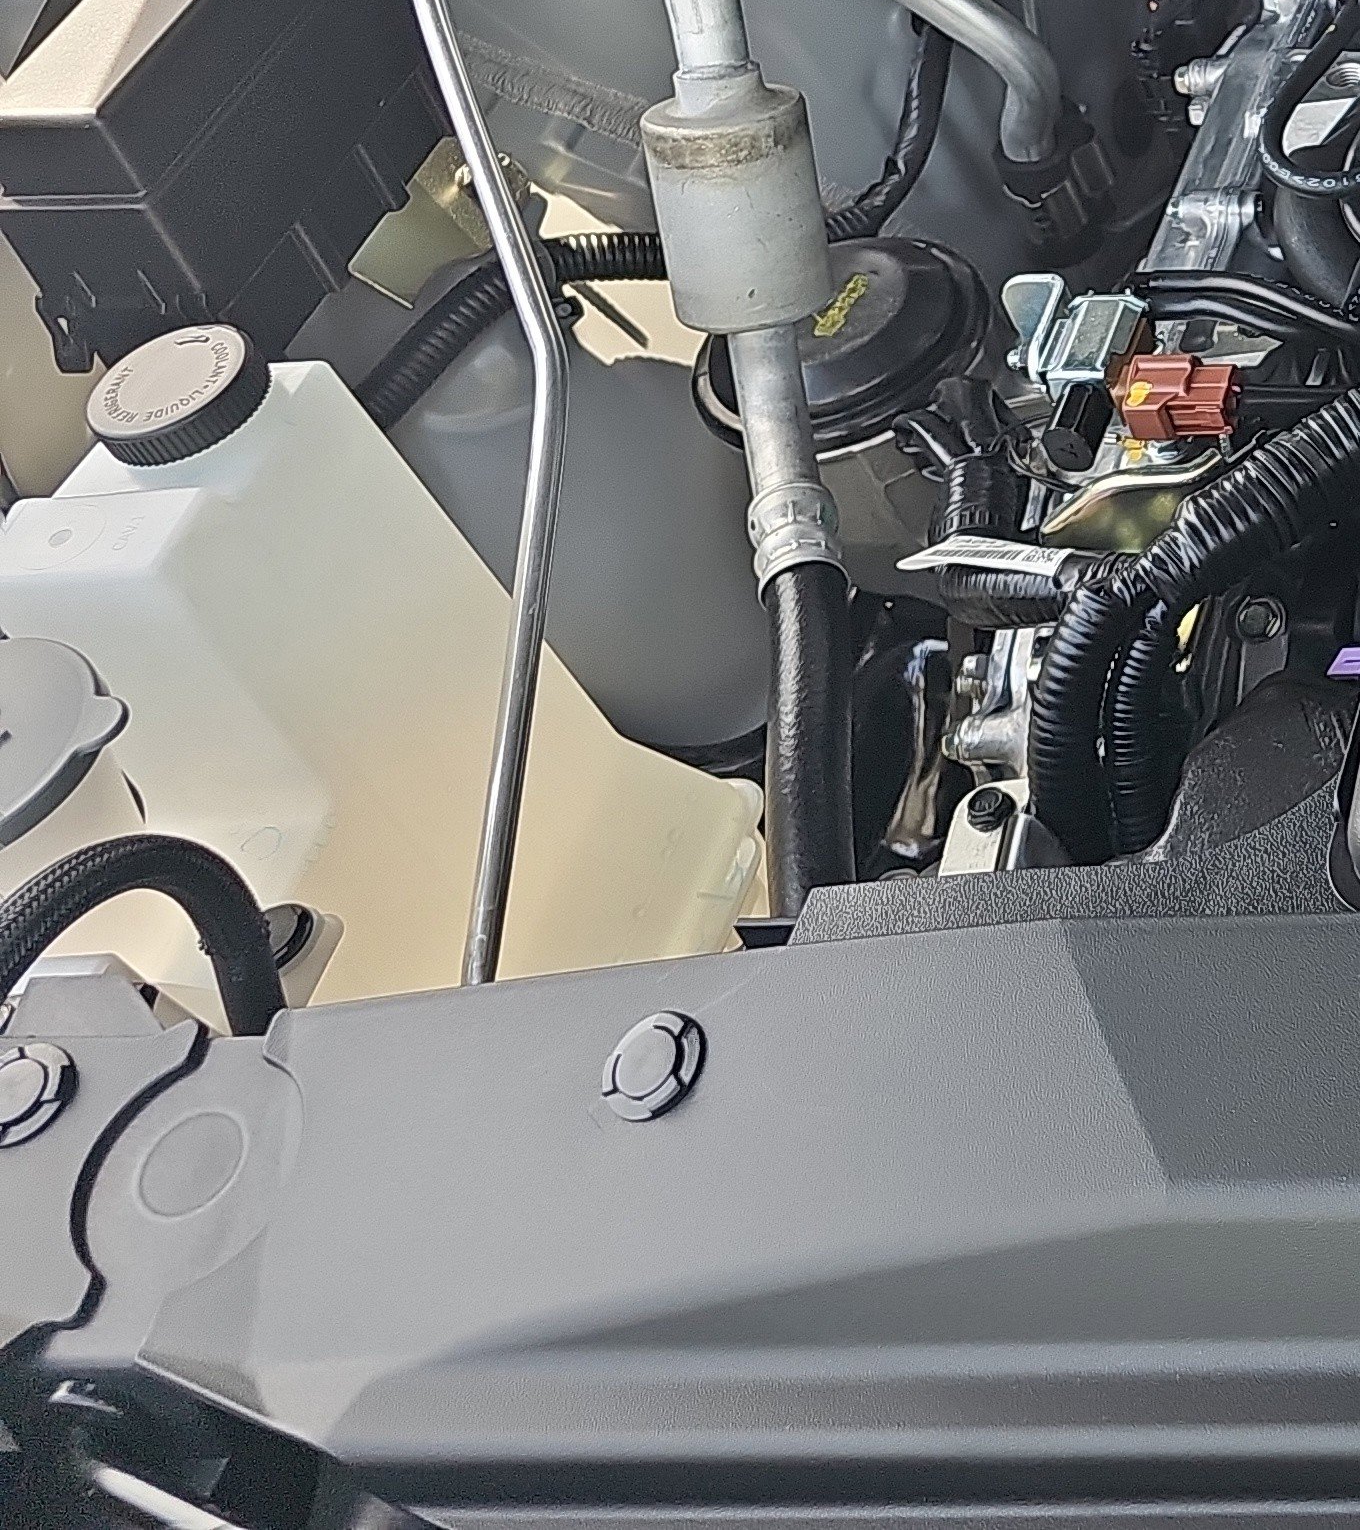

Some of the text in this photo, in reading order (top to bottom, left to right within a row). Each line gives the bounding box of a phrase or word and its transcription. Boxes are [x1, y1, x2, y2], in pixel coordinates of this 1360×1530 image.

[103, 341, 230, 424] COOLANT LIQUIDE REFRIGERANT
